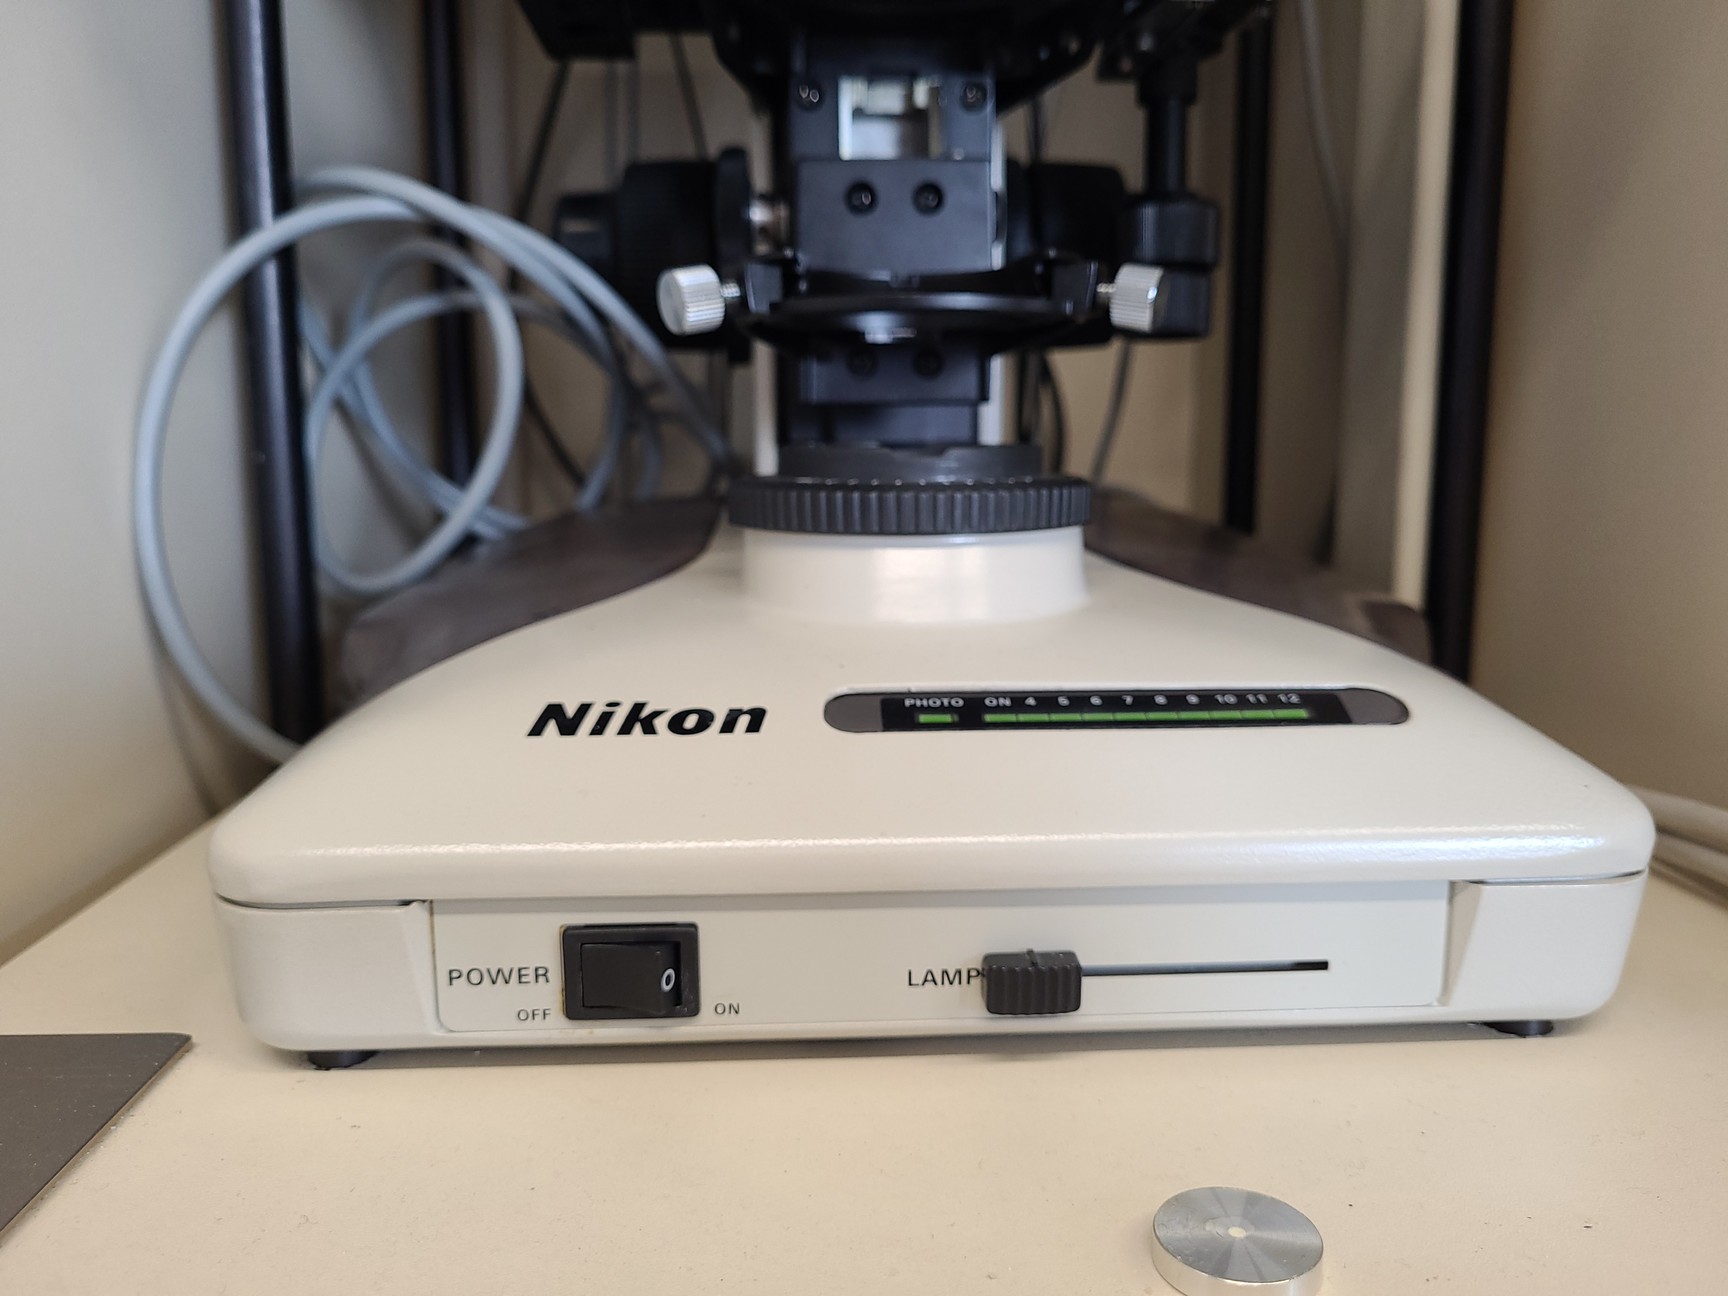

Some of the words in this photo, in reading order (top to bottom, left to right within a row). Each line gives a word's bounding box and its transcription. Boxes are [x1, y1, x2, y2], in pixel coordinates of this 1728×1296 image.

[904, 697, 965, 708] PHOTO
[984, 696, 1012, 708] ON
[1024, 696, 1037, 707] 4
[1057, 695, 1071, 706] 5
[1089, 695, 1103, 706] 6
[1121, 694, 1134, 706] 7
[1153, 694, 1168, 705] 8
[1185, 694, 1200, 705] 9
[1214, 693, 1239, 705] 10
[1245, 693, 1268, 704] 11
[1277, 693, 1301, 704] 12
[527, 702, 767, 736] Nikon
[448, 966, 550, 986] POWER
[908, 968, 982, 987] LAMP
[517, 1008, 551, 1022] OFF
[714, 1002, 741, 1015] ON
